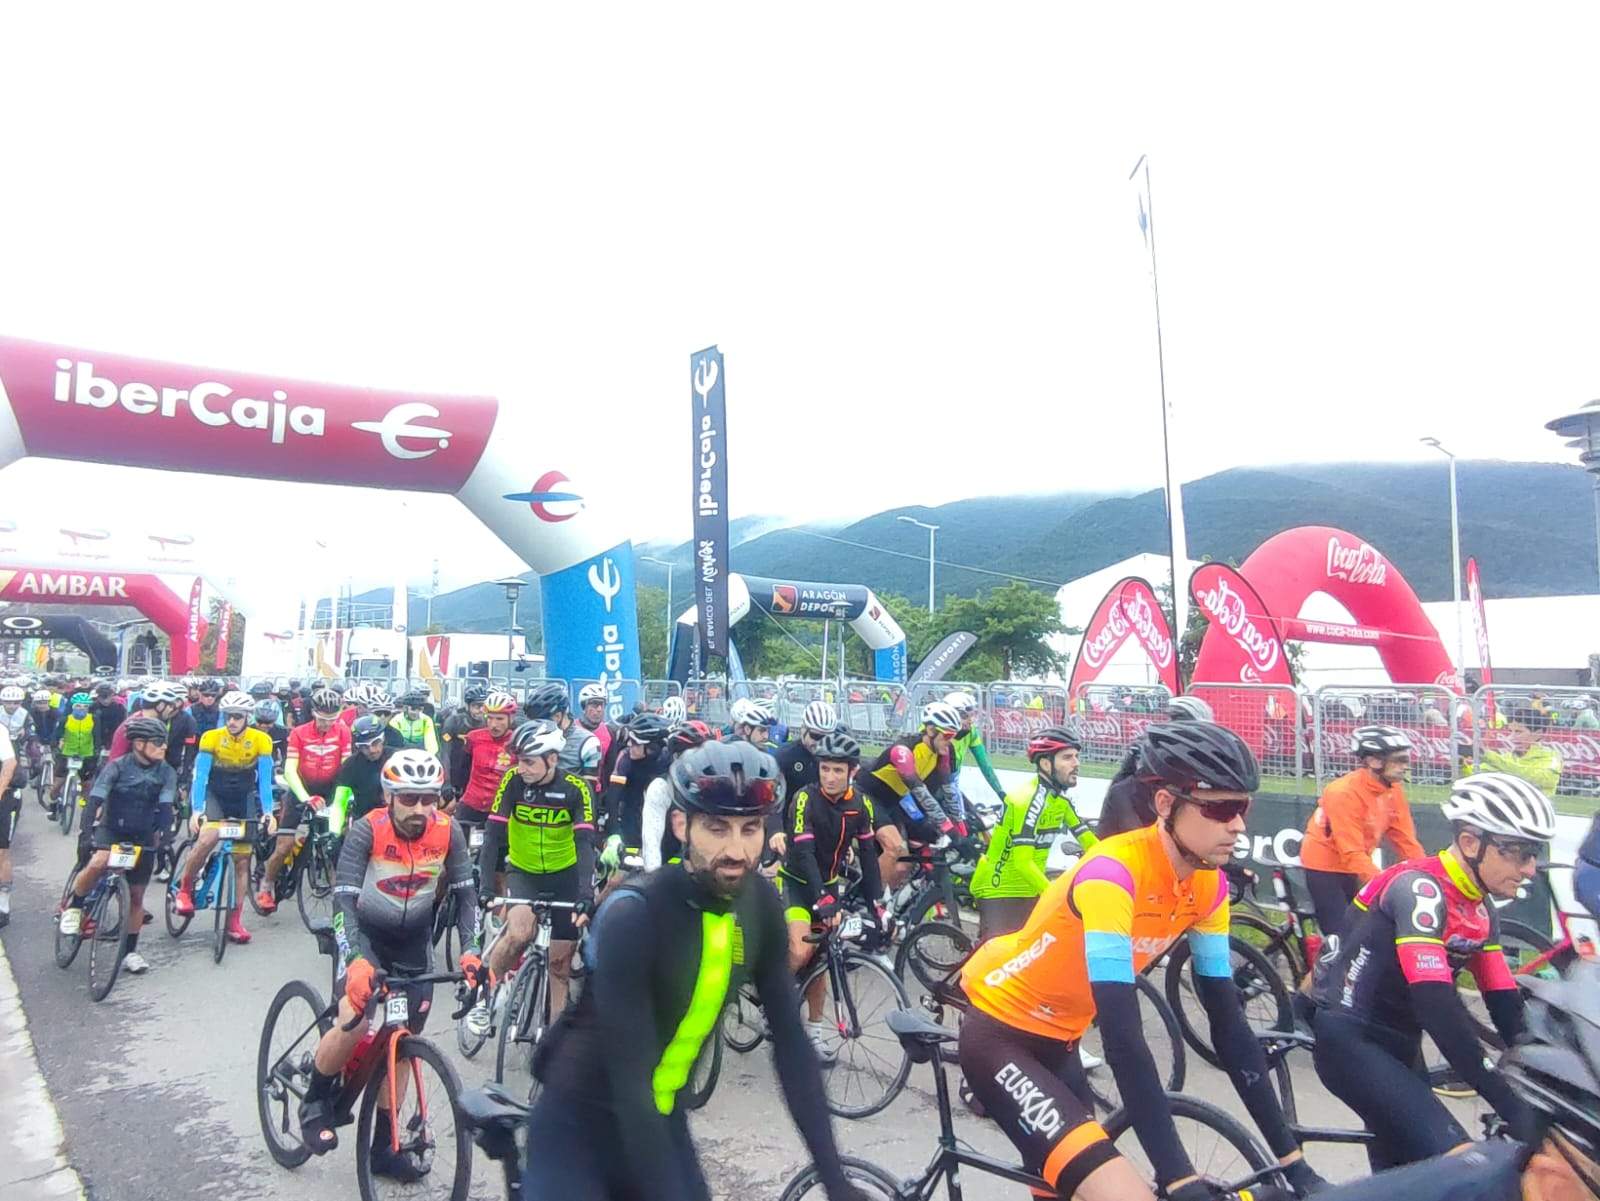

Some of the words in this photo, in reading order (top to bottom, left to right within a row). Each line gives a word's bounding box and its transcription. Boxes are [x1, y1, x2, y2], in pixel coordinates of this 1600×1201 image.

[54, 358, 326, 443] iberCaja
[18, 572, 130, 598] AMBAR
[0, 629, 51, 637] AKLEY
[515, 804, 572, 824] EGIA
[983, 931, 1057, 987] ORBEA
[388, 999, 408, 1015] 153
